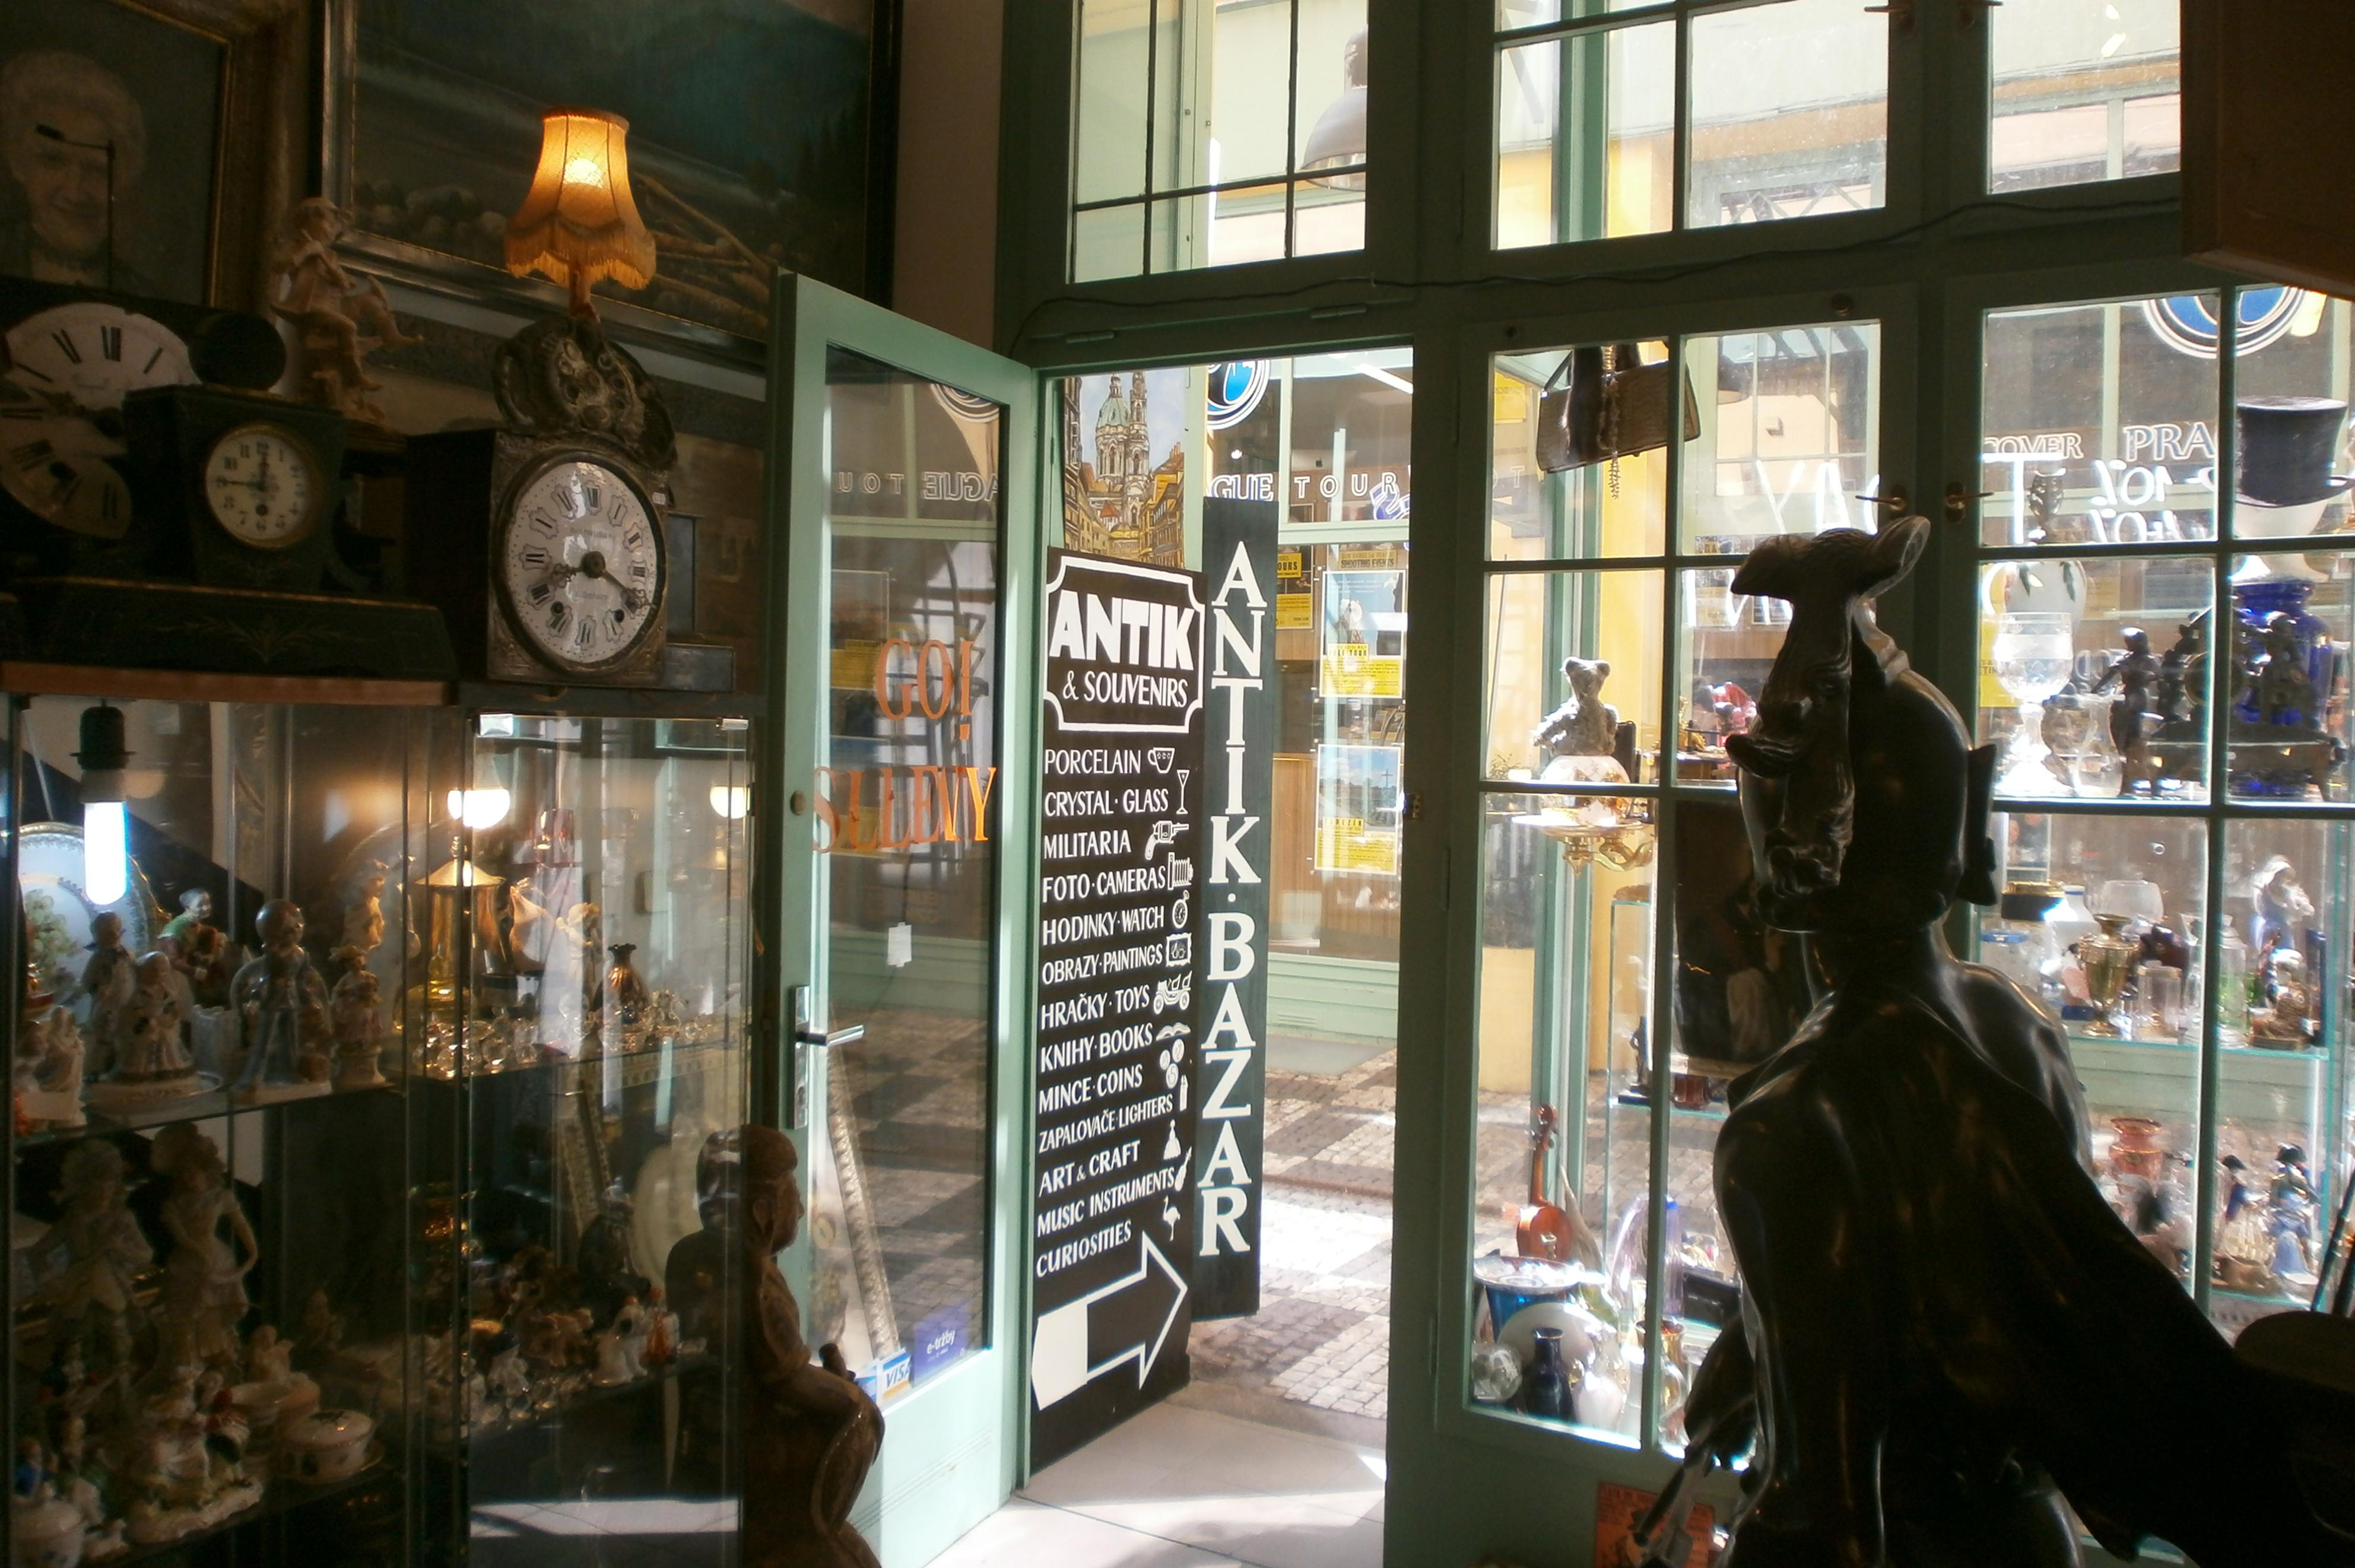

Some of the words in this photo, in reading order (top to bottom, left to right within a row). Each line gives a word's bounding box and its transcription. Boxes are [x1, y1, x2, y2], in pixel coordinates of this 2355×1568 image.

[1049, 589, 1195, 671] ANTIK
[1062, 670, 1079, 700] &
[1084, 671, 1188, 708] SOUVENIRS
[1045, 749, 1141, 775] PORCELAIN
[1045, 791, 1114, 817] CRYSTAL
[1123, 788, 1169, 814] GLASS
[1044, 830, 1131, 859] MILITARIA
[1043, 873, 1091, 903] FOTO
[1097, 865, 1166, 895] CAMERAS
[1043, 911, 1118, 945] HODINKY
[1121, 906, 1164, 932] WATCH
[1042, 955, 1099, 985] OBRAZY
[1103, 944, 1163, 974] PAINTINGS
[1041, 989, 1107, 1030] HRAČKY
[1115, 985, 1150, 1014] TOYS
[1041, 1036, 1095, 1072] KNIHY
[1100, 1023, 1153, 1058] BOOKS
[1039, 1077, 1091, 1115] MINCE
[1098, 1064, 1143, 1097] COINS
[1119, 1094, 1173, 1128] LIGHTERS
[1039, 1162, 1075, 1197] ART
[1077, 1166, 1087, 1182] &
[1089, 1140, 1141, 1177] CRAFT
[1037, 1202, 1084, 1237] MUSIC
[1090, 1167, 1175, 1217] INSTRUMENTS
[1036, 1219, 1132, 1278] CURIOSITIES
